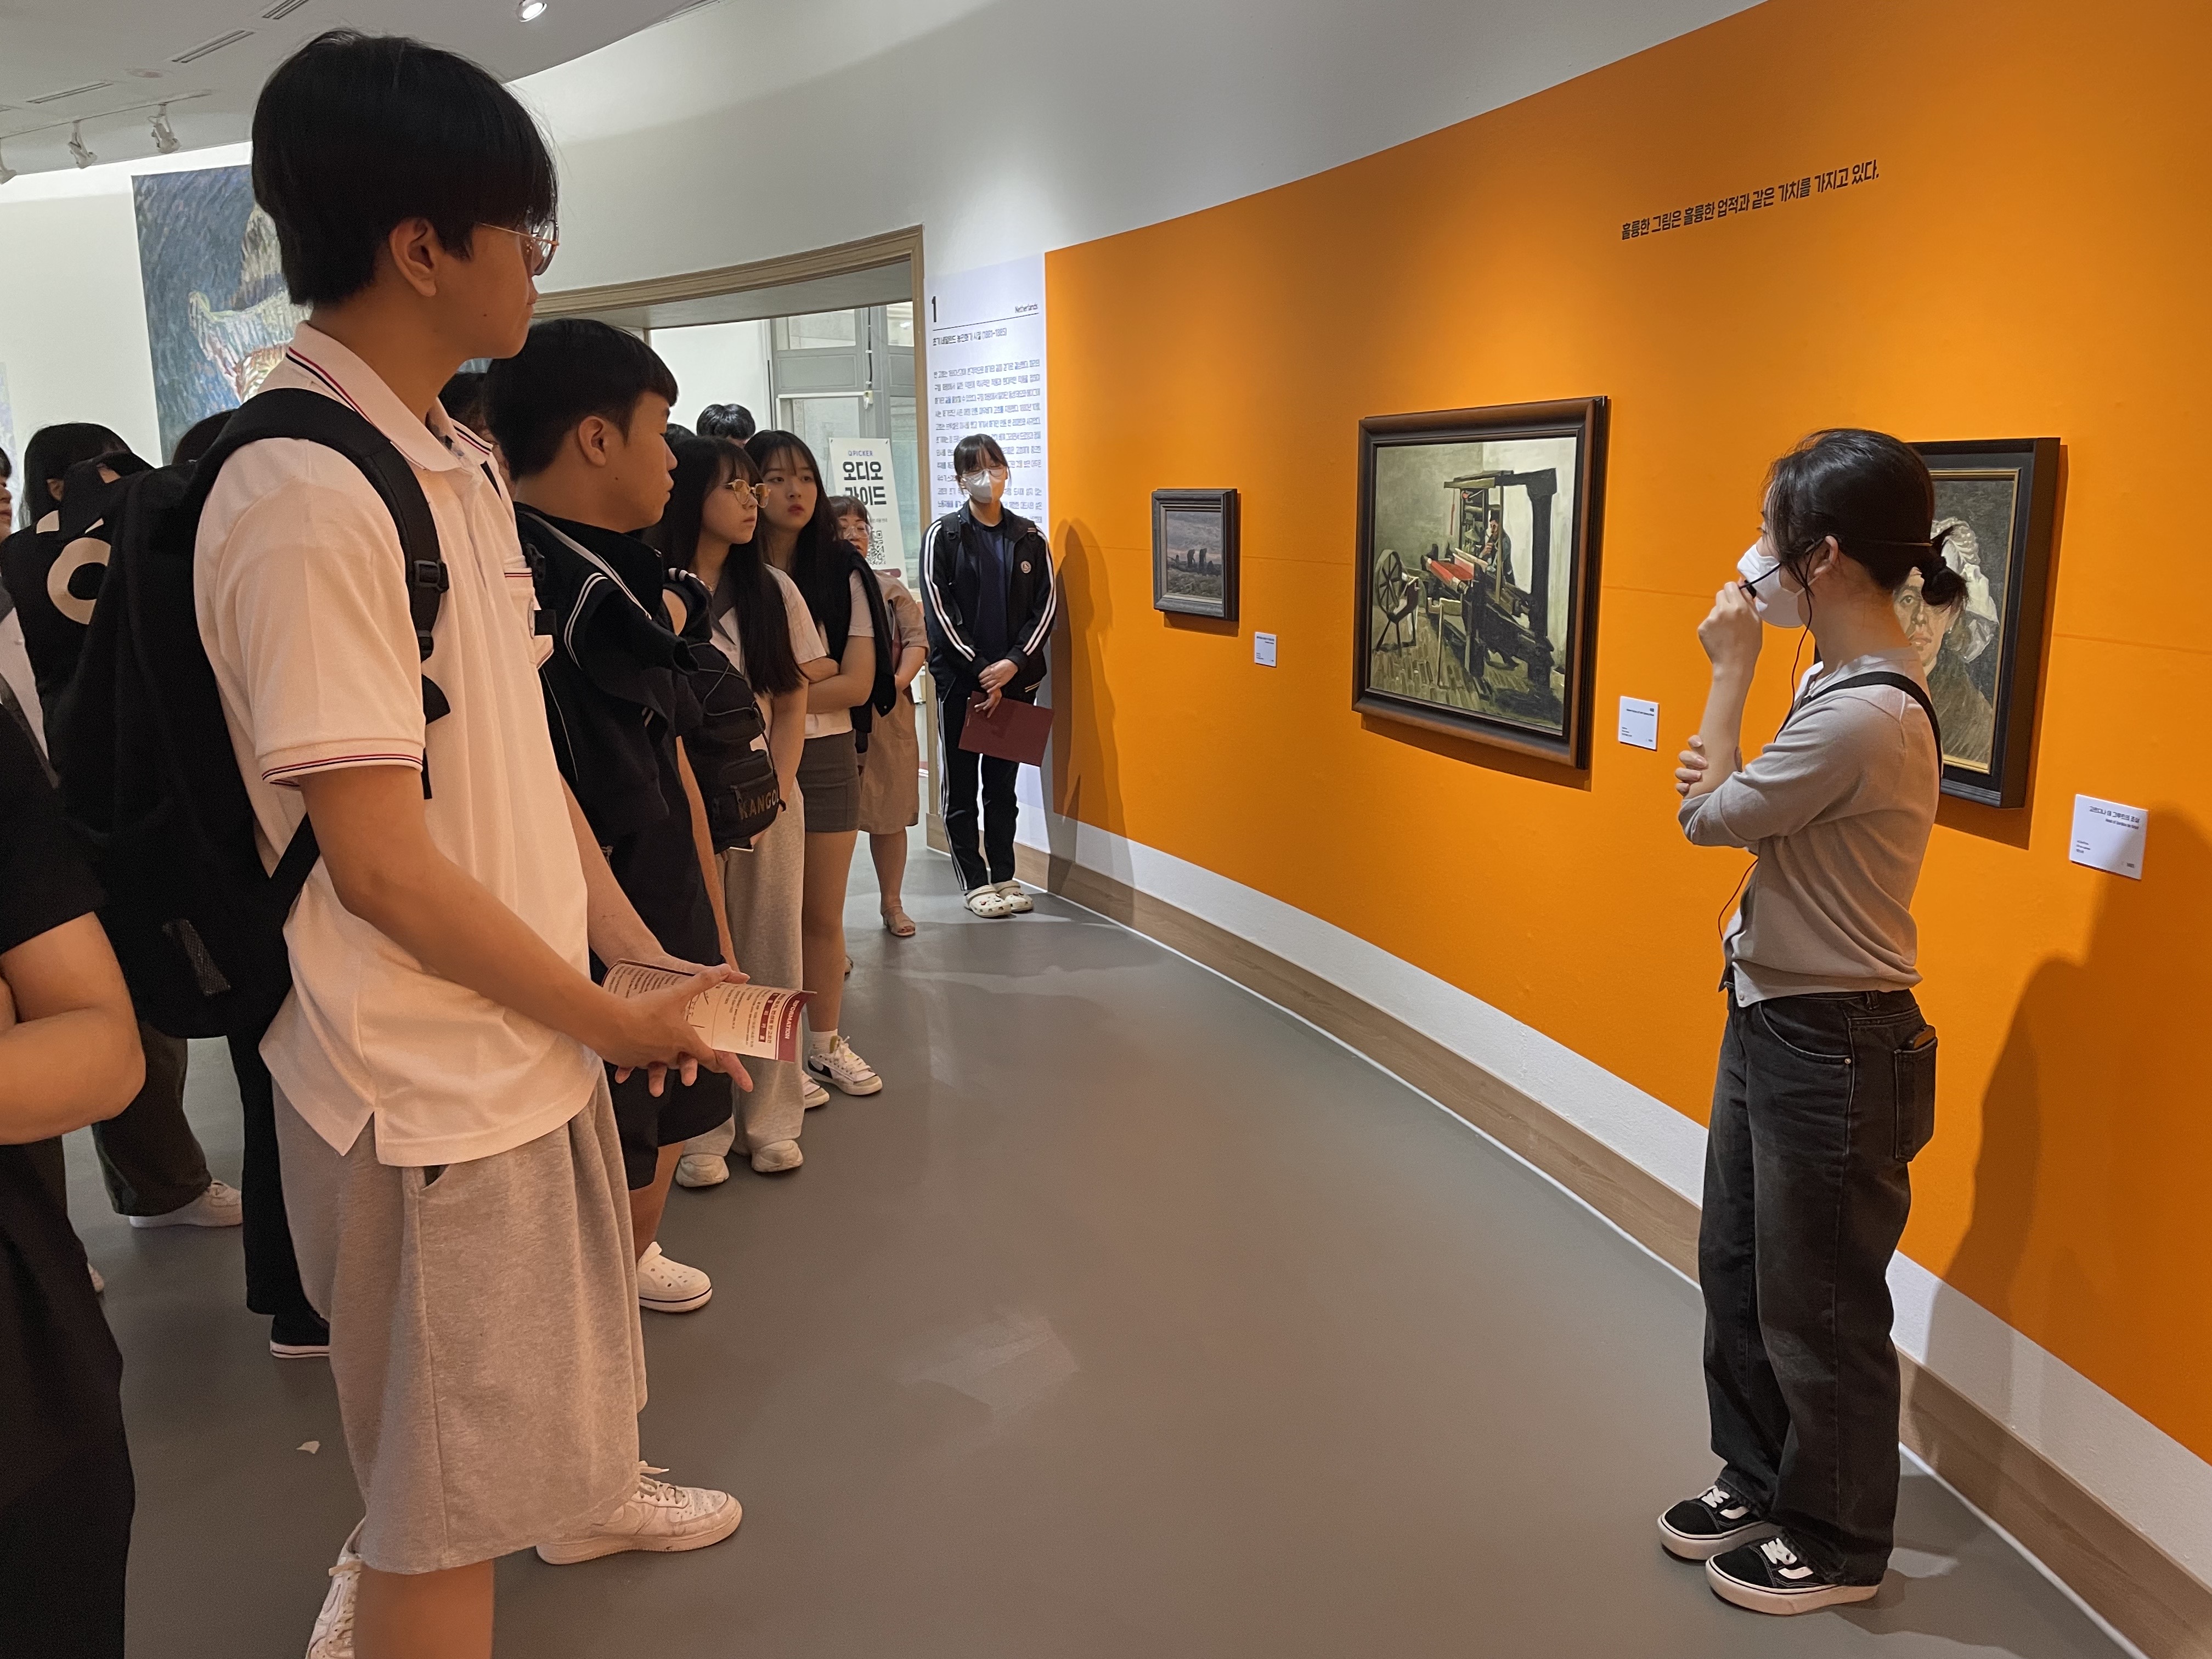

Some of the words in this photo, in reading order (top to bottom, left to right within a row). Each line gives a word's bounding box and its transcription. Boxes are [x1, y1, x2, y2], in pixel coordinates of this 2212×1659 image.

[1622, 217, 1650, 240] 훌륭한
[1651, 210, 1681, 233] 그림은
[1684, 201, 1715, 226] 훌륭한
[1718, 193, 1750, 218] 업적과
[1752, 187, 1775, 210] 같은
[1778, 177, 1811, 202] 가치를
[1814, 167, 1849, 193] 가지고
[1852, 159, 1880, 185] 있다.
[932, 296, 936, 323] 1
[1015, 303, 1038, 313] Netherlands
[843, 461, 883, 481] 오디오
[785, 1000, 799, 1040] INFORMATION
